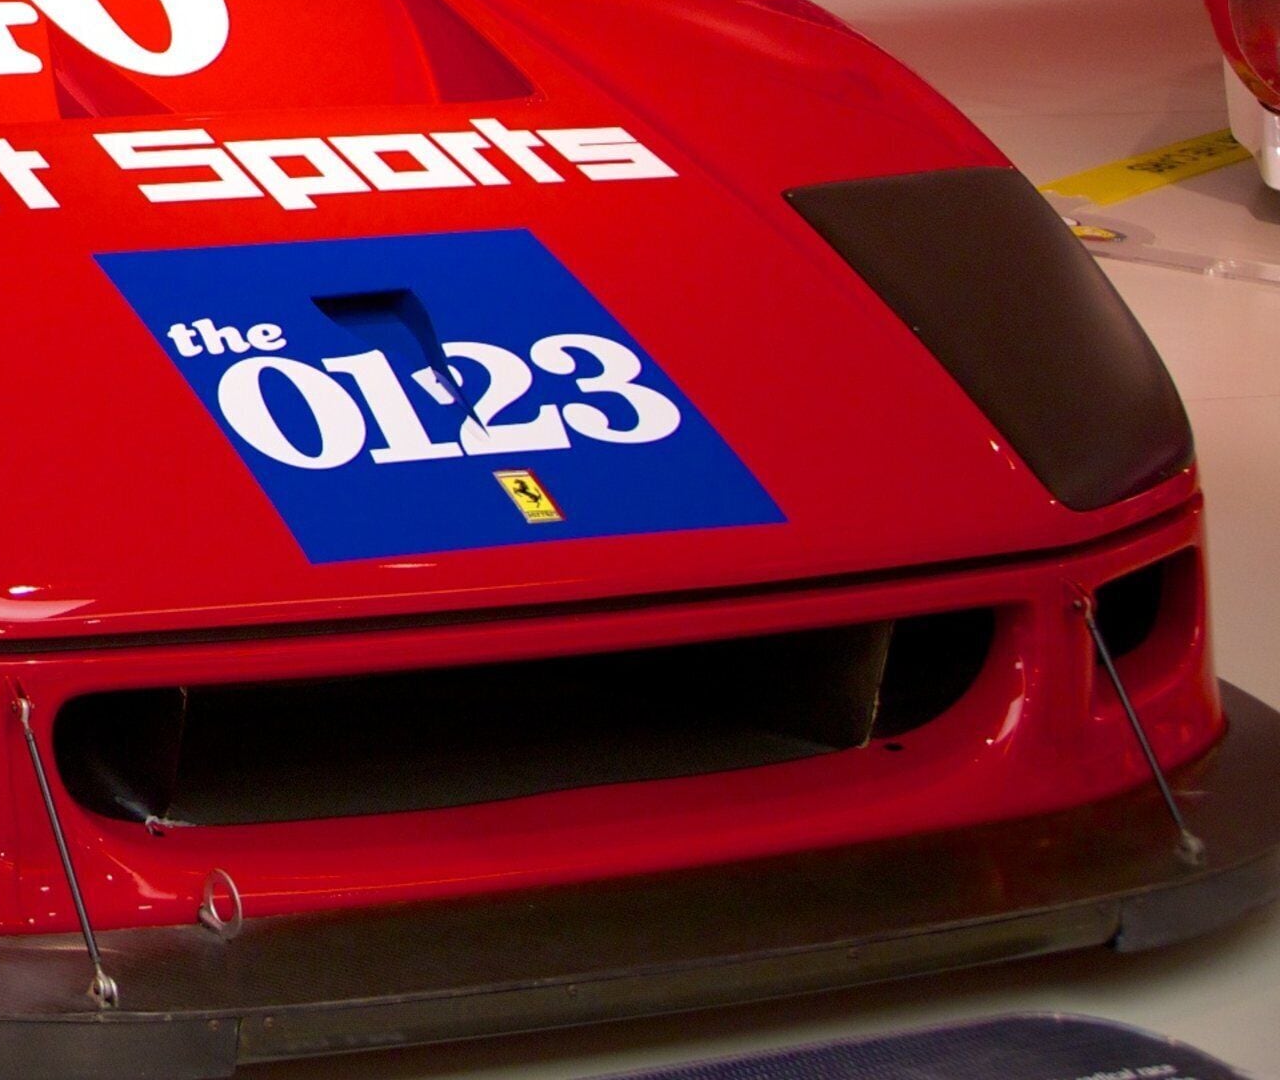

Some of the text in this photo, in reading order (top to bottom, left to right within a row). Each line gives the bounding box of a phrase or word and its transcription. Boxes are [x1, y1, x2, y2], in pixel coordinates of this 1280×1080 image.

[94, 117, 679, 211] Sports
[167, 317, 287, 358] the
[216, 332, 682, 471] 0123
